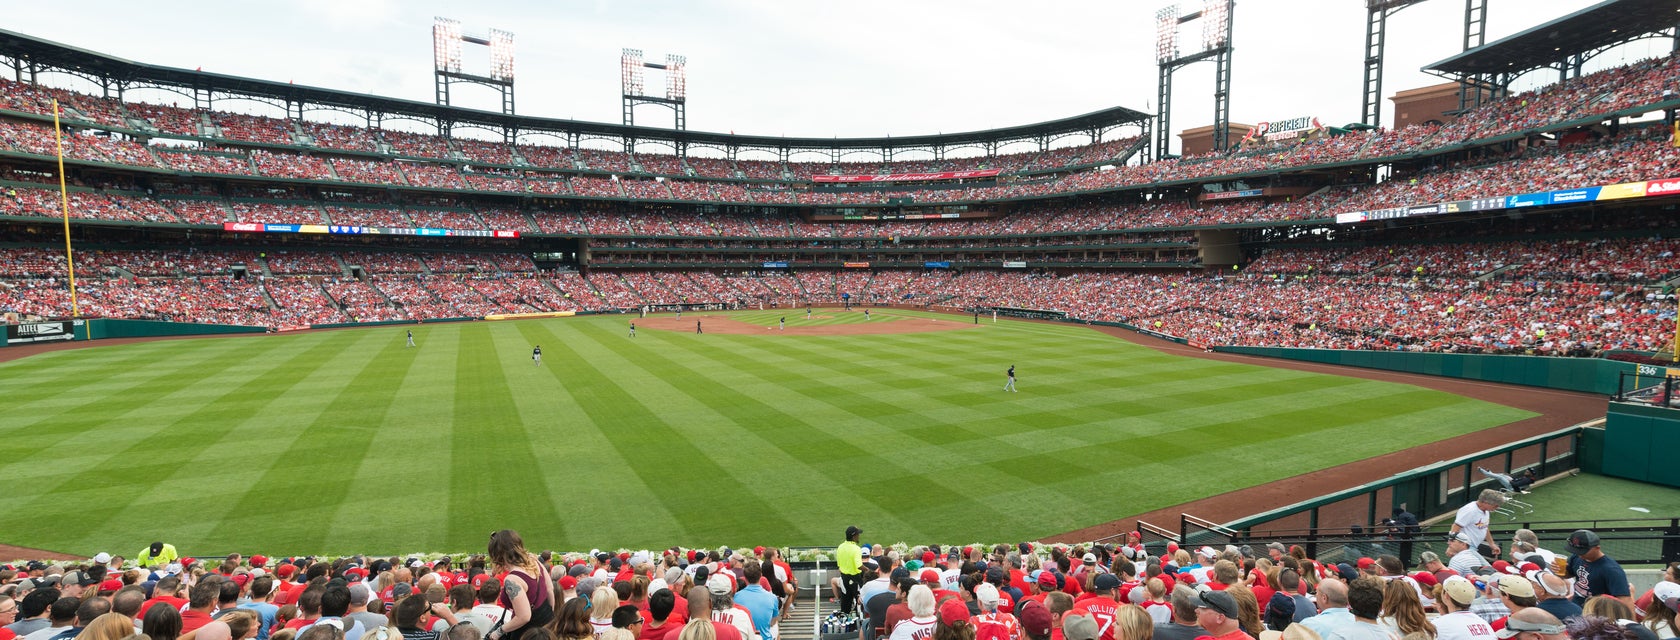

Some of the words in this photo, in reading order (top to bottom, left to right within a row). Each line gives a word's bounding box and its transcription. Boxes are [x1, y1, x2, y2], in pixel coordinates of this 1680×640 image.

[1257, 117, 1310, 136] PERFICIENT
[872, 173, 943, 181] Budweiser
[1097, 613, 1112, 637] 7
[1467, 623, 1490, 637] HERR
